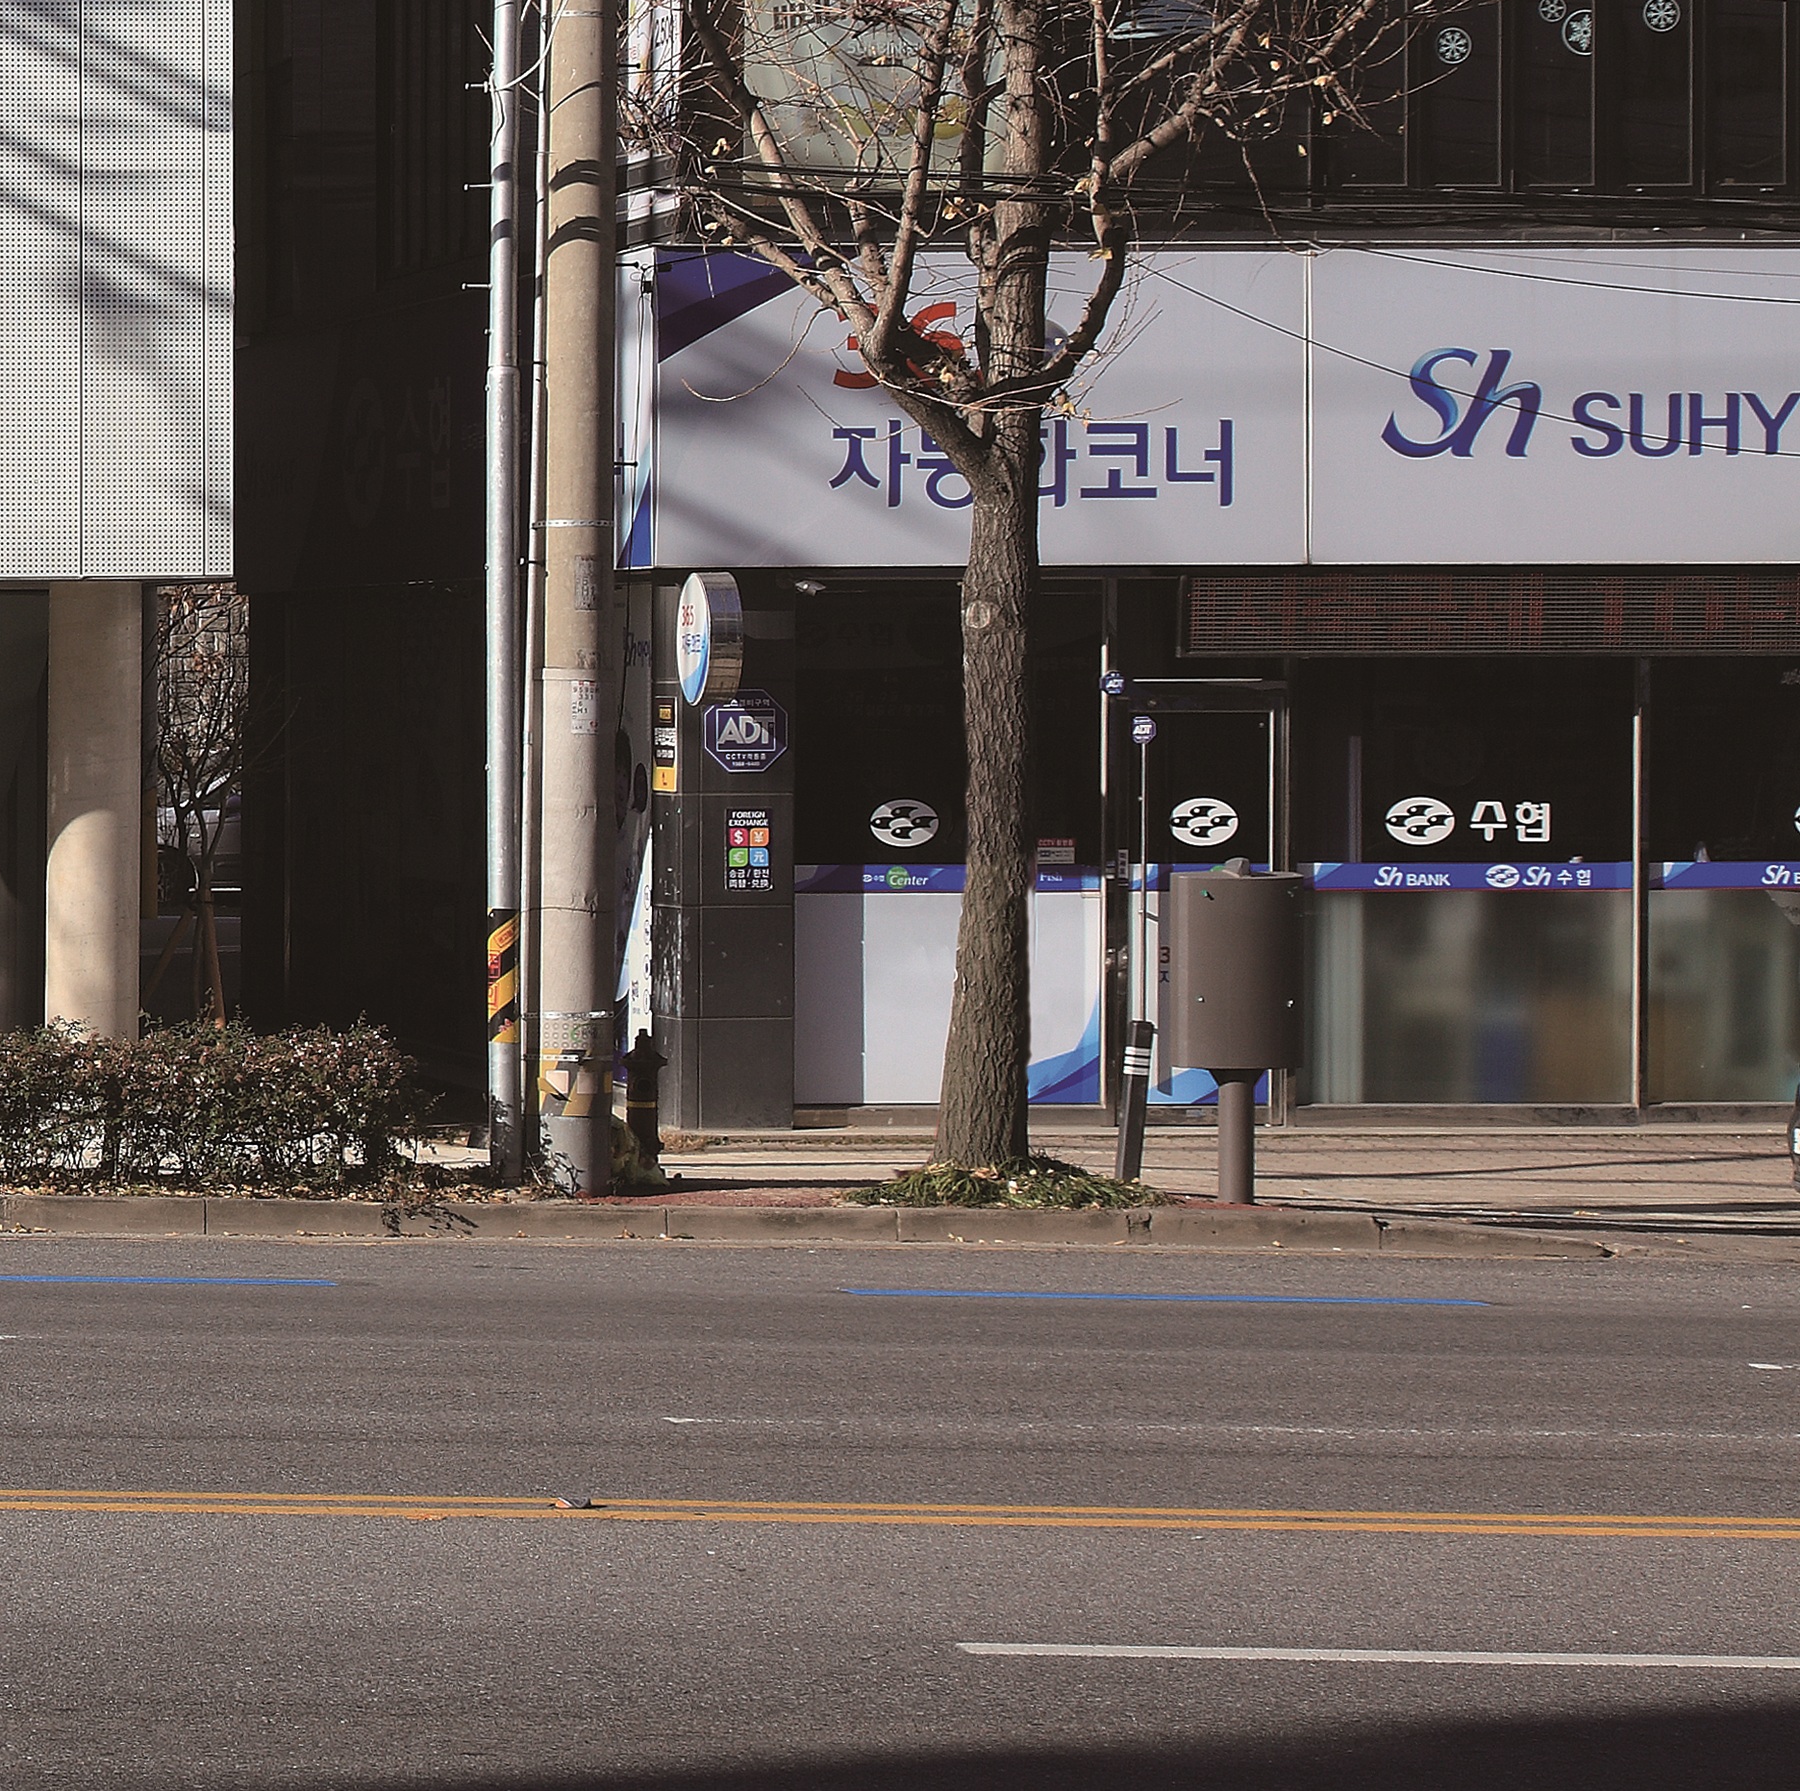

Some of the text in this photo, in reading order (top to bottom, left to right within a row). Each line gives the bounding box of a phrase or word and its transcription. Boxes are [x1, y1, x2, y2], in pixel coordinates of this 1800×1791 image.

[1383, 348, 1541, 459] Sh
[681, 605, 695, 627] 365
[717, 716, 774, 745] ADT
[1133, 724, 1151, 735] ADT
[1470, 800, 1552, 842] 수협
[734, 829, 764, 844] $ ¥
[733, 851, 765, 863] € 元
[890, 875, 929, 886] Center
[1373, 865, 1450, 887] Sh BANK
[1522, 865, 1592, 887] Sh 수협
[1761, 864, 1790, 885] Sh
